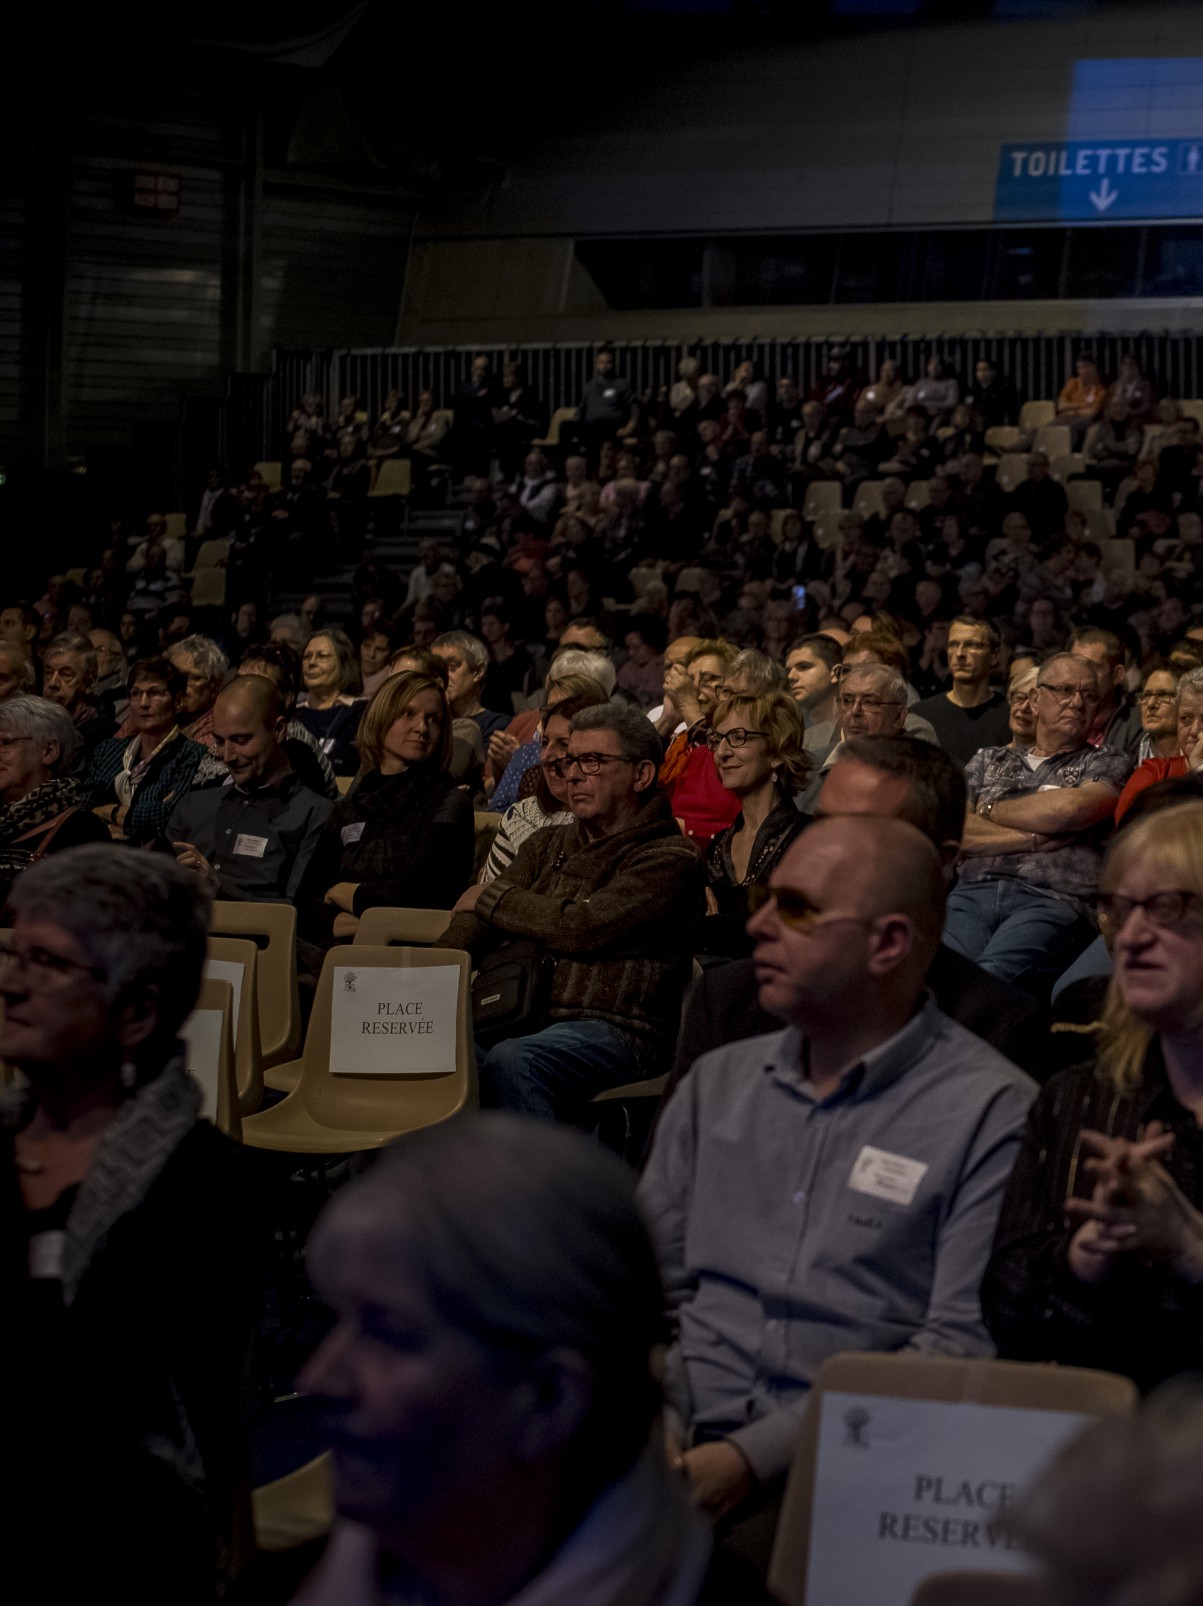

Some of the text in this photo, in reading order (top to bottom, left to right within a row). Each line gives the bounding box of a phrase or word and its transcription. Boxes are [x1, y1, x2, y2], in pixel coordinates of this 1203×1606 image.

[1010, 146, 1168, 177] TOILETTES
[377, 1002, 423, 1015] PLACE
[361, 1018, 434, 1035] RESERVÉE
[878, 1511, 1020, 1551] RESERV
